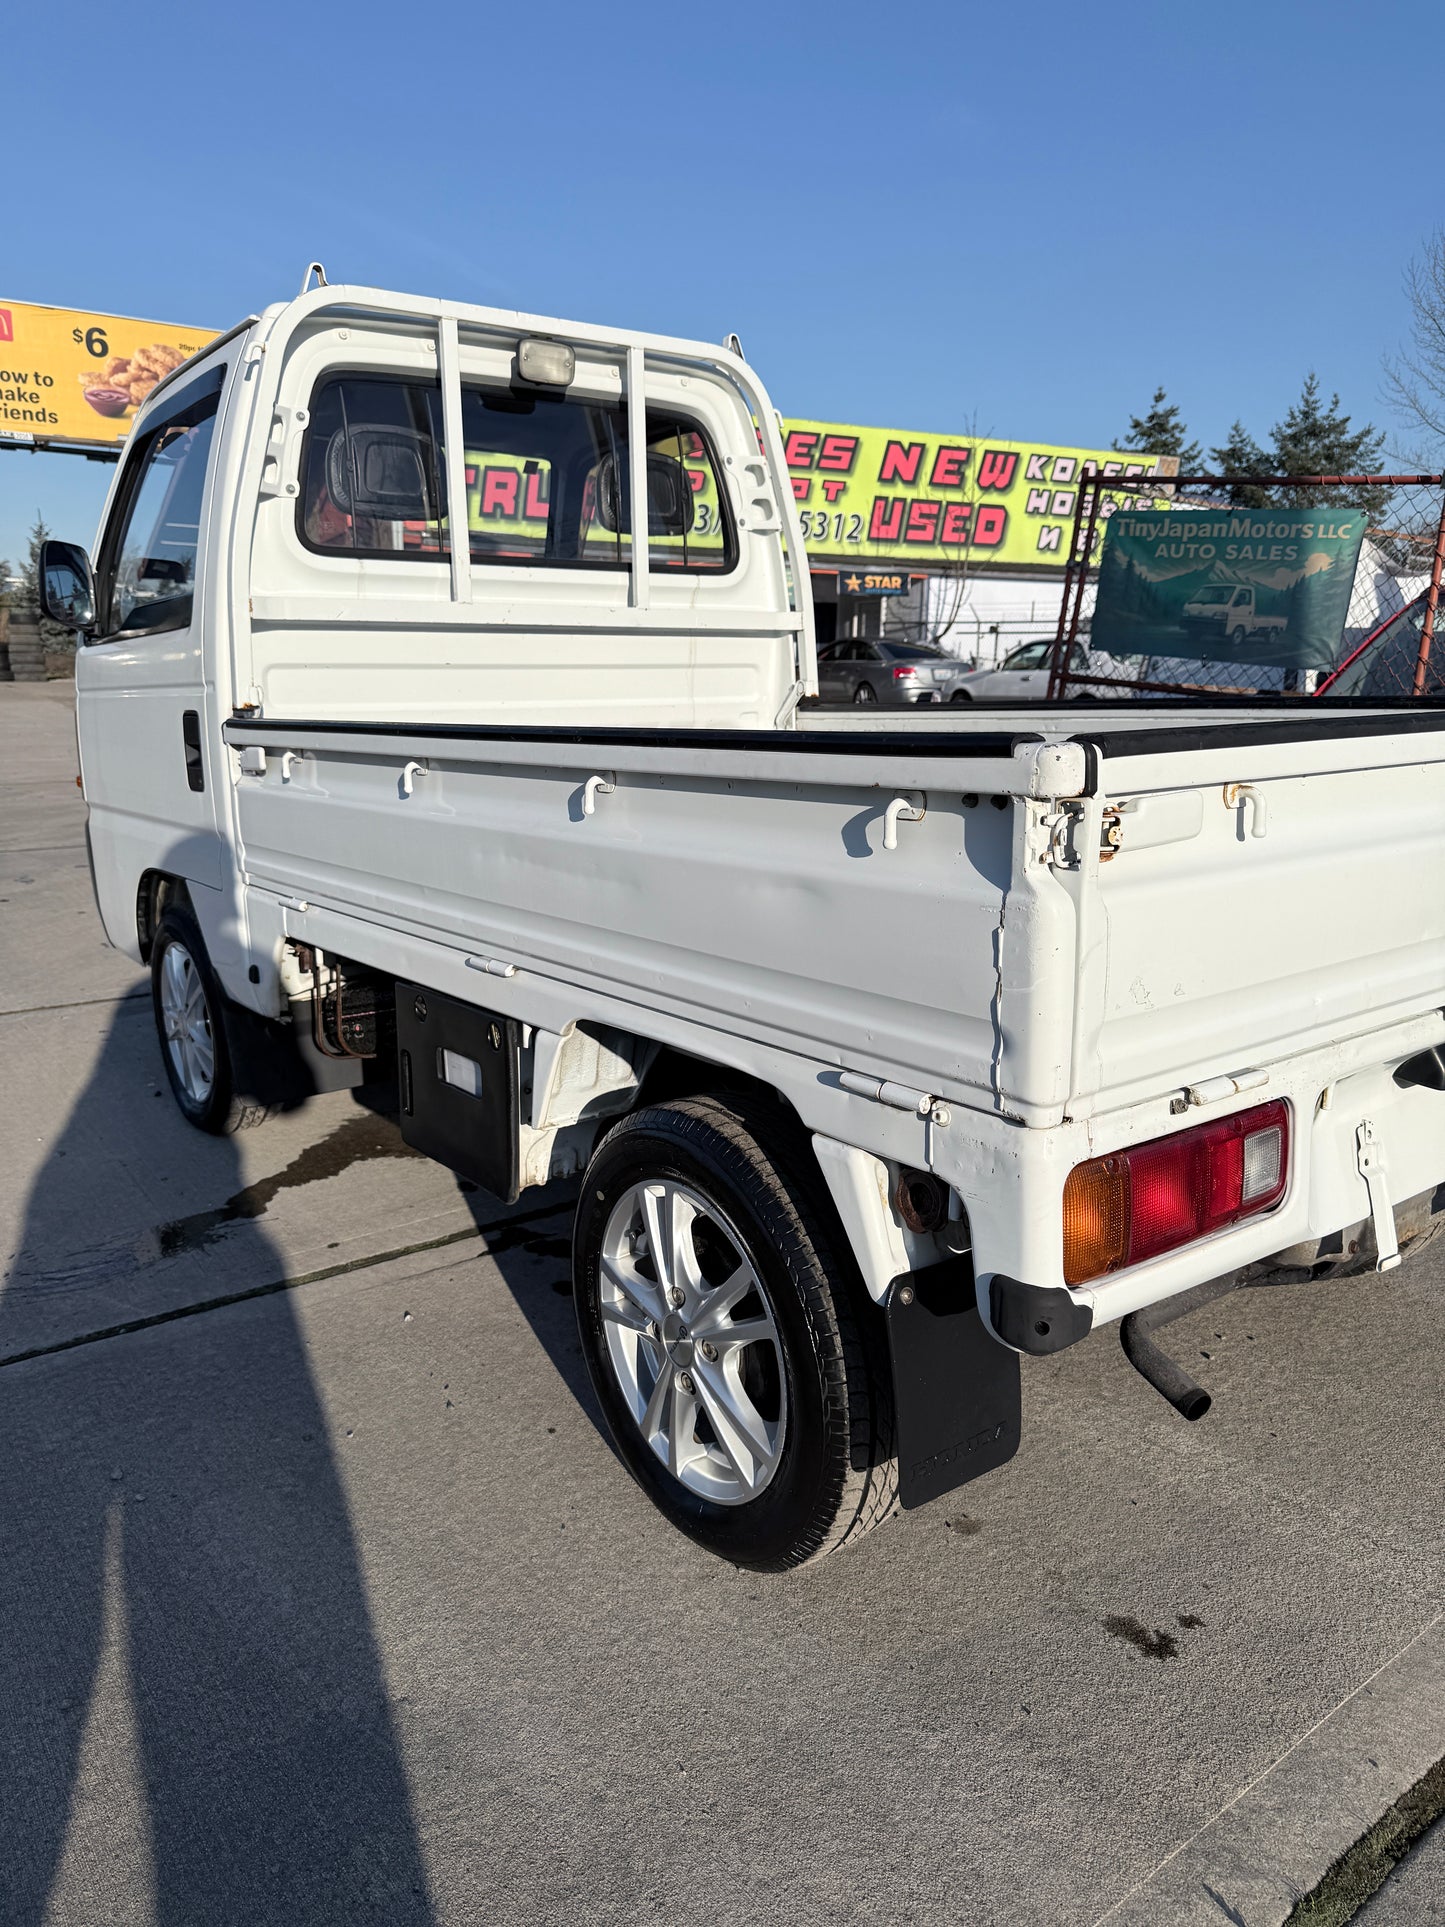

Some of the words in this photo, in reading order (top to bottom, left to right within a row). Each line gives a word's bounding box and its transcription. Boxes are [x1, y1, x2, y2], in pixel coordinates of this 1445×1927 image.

[72, 326, 109, 358] $6
[33, 371, 54, 388] to
[878, 439, 1020, 491] NEW
[868, 496, 1008, 549] USED
[1318, 523, 1352, 541] LLC
[1154, 543, 1217, 559] AUTO
[1225, 544, 1298, 562] SALES
[864, 574, 902, 589] STAR
